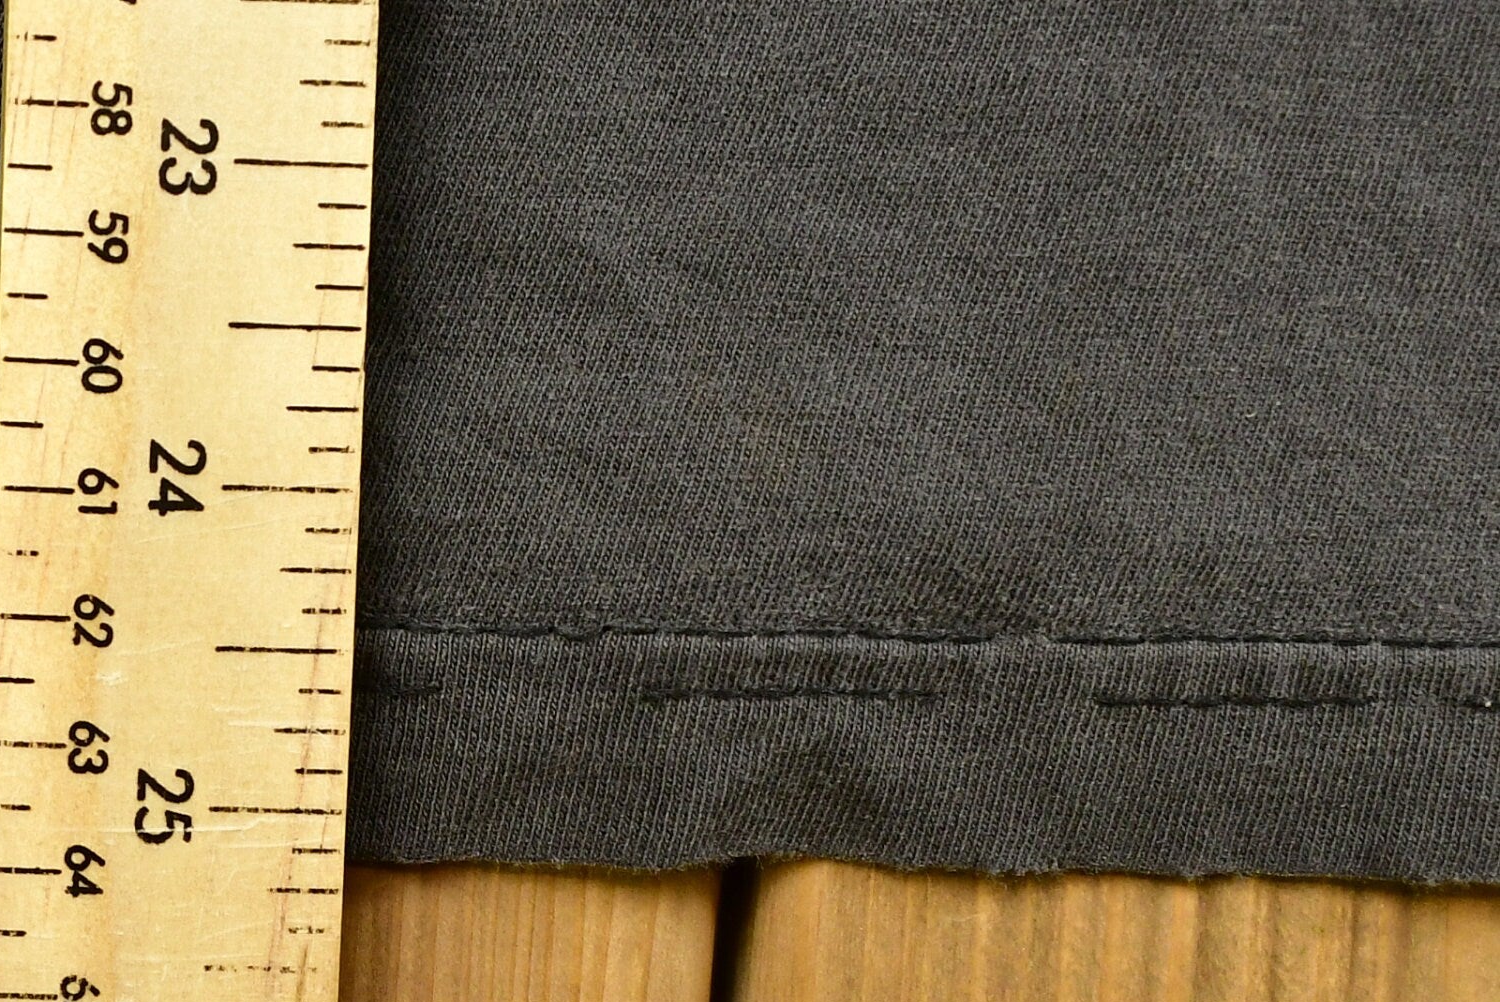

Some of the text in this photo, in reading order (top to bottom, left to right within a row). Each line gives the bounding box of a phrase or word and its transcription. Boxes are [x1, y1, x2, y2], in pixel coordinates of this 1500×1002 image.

[91, 81, 132, 136] 58
[159, 119, 218, 195] 23
[88, 210, 129, 264] 59
[81, 338, 123, 394] 60
[78, 468, 119, 515] 61
[148, 439, 206, 516] 24
[73, 594, 114, 648] 62
[68, 721, 110, 774] 63
[135, 769, 194, 845] 25
[64, 845, 105, 898] 64
